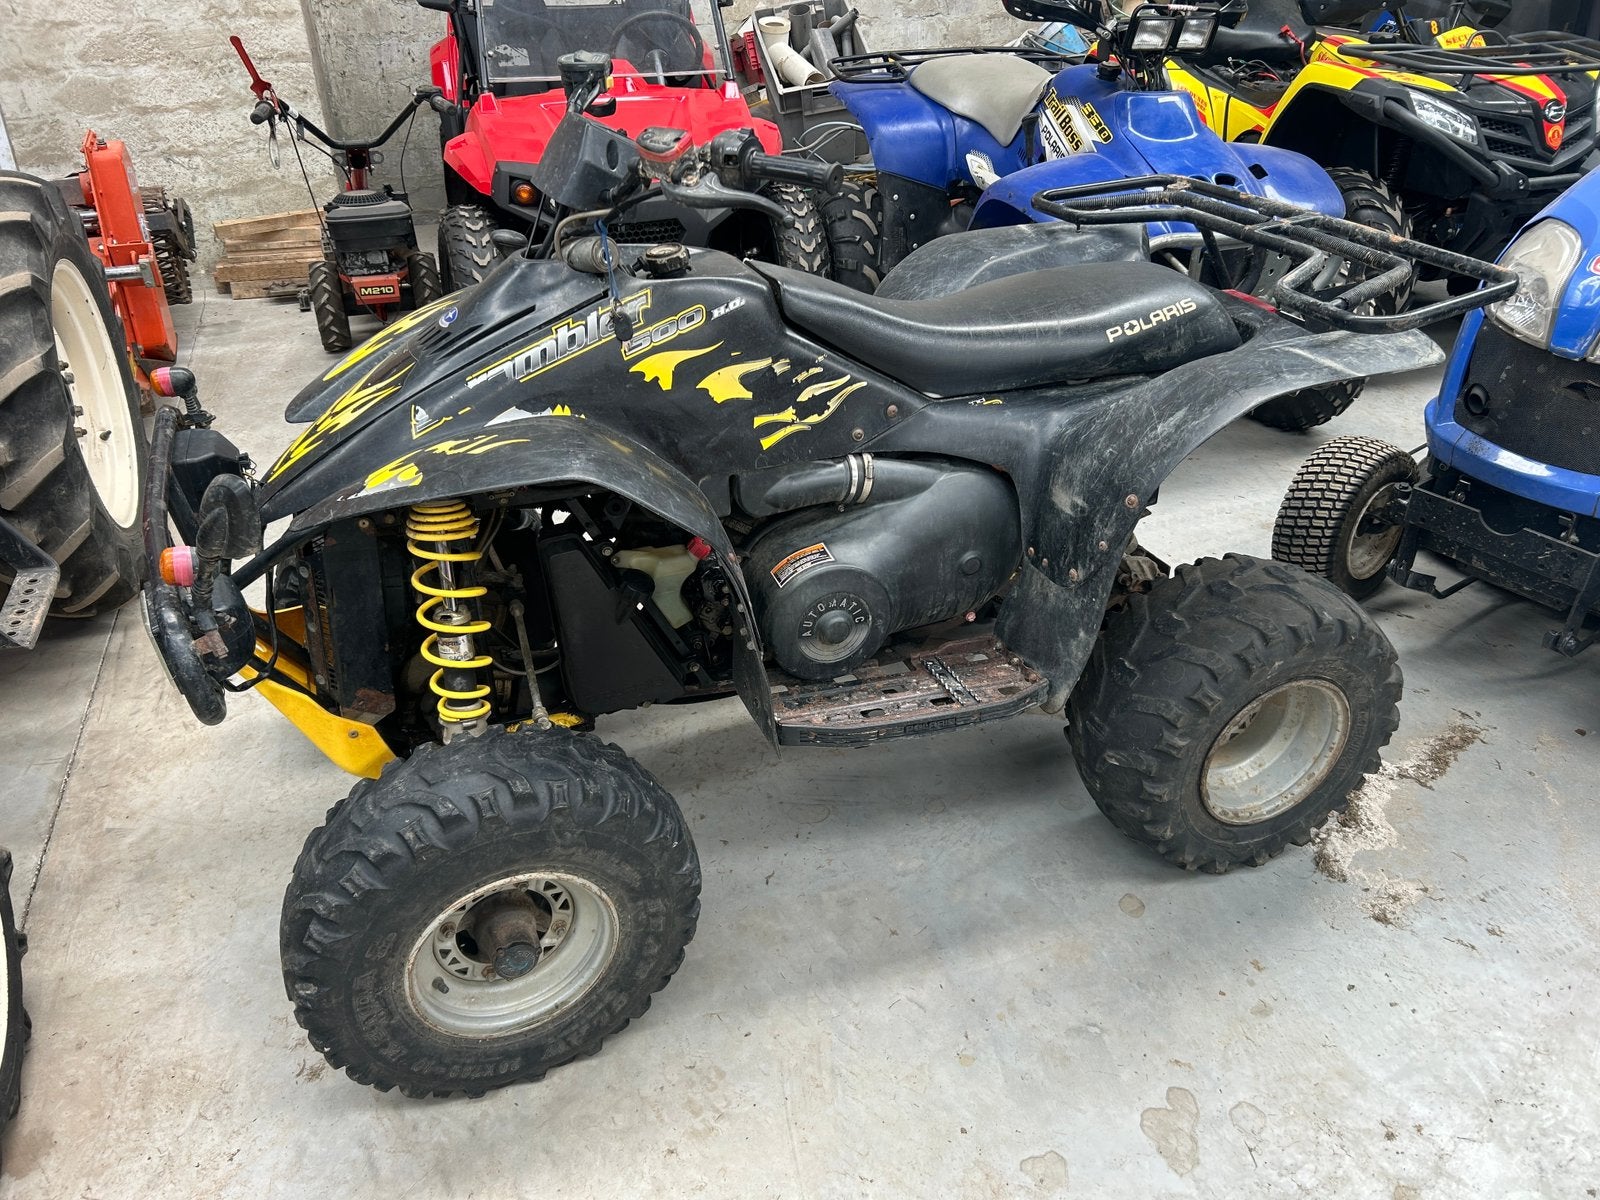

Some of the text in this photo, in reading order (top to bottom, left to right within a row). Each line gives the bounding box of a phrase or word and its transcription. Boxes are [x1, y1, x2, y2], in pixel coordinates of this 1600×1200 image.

[1430, 19, 1439, 35] 8
[1045, 87, 1083, 152] Trail Boss
[1081, 103, 1113, 144] 330
[360, 286, 394, 296] M210
[624, 305, 705, 358] 500
[1105, 297, 1197, 344] POLARIS
[802, 598, 865, 638] AUTOMATIC
